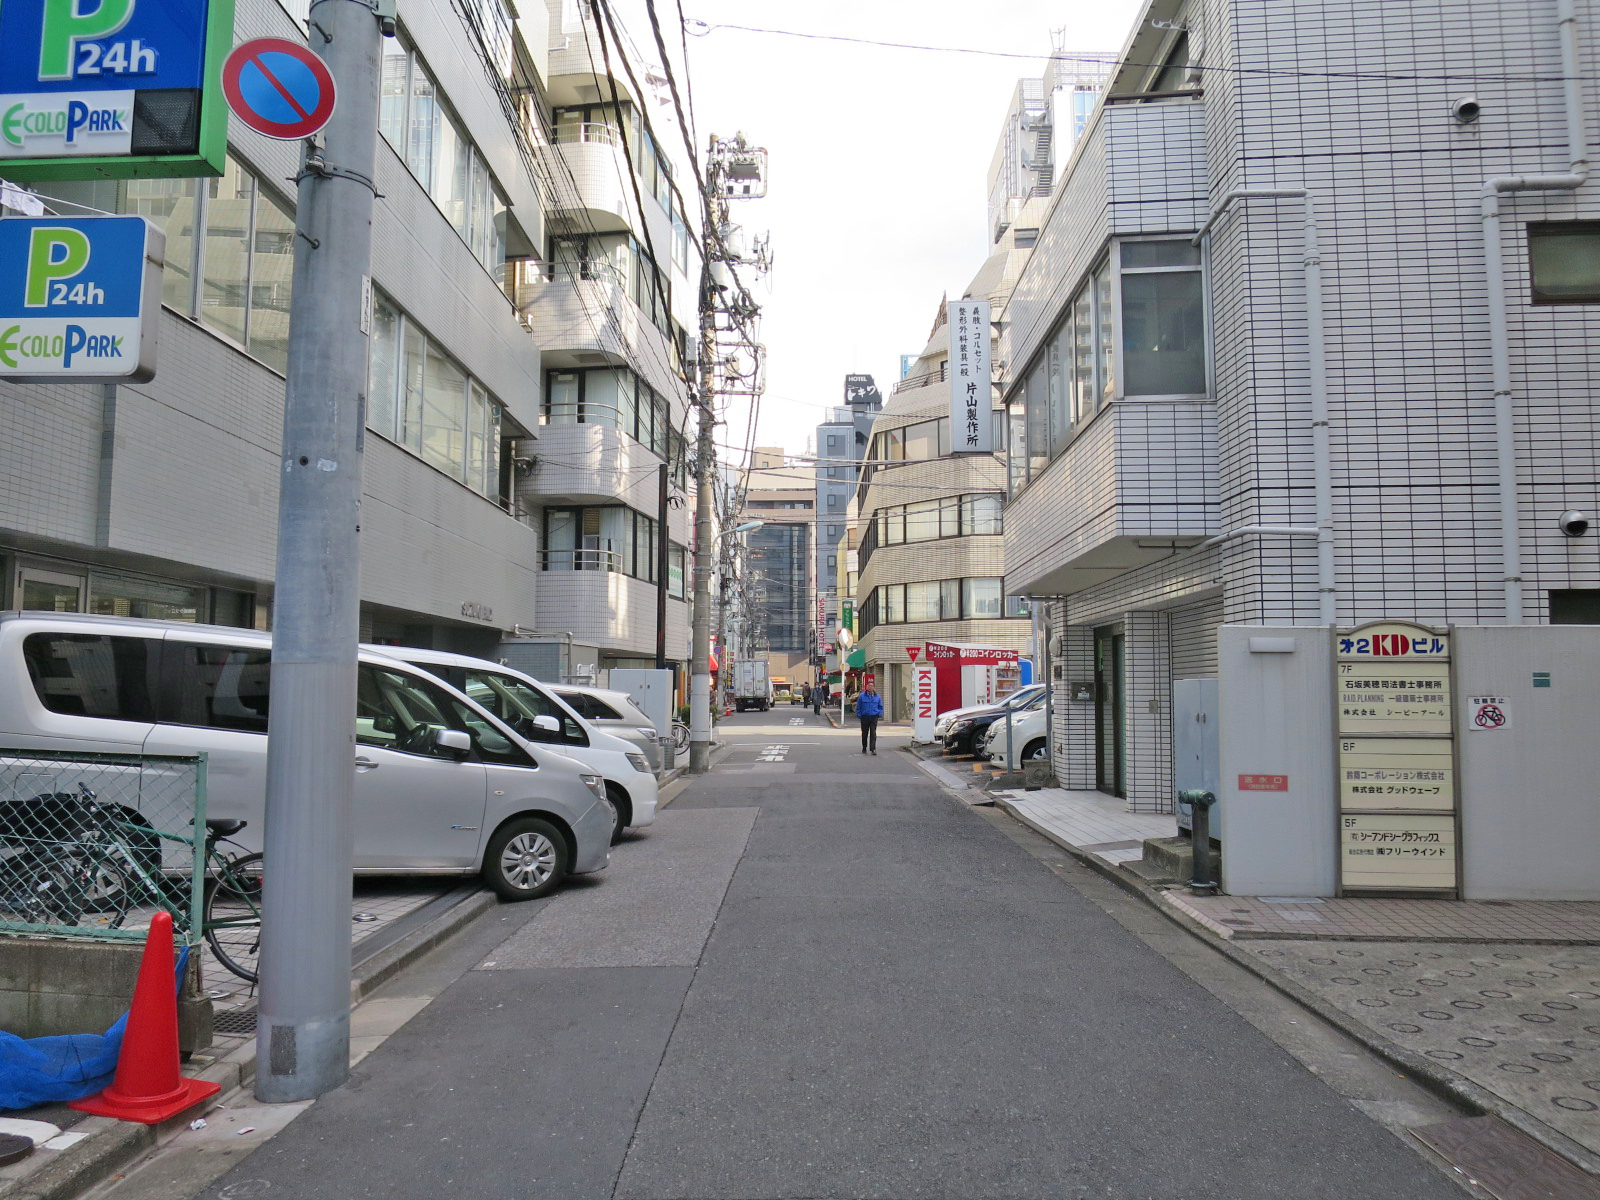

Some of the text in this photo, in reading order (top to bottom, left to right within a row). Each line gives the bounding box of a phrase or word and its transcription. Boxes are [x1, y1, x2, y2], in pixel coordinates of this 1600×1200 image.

[39, 0, 132, 81] P
[77, 42, 158, 75] 24h
[24, 227, 92, 308] P
[51, 282, 105, 305] 24h
[958, 306, 970, 377] 整形外科装具一般
[847, 385, 877, 401] トキワ
[966, 381, 979, 447] 片山製作所
[818, 597, 826, 650] SAKURA HOTEL
[1341, 665, 1353, 674] 7F
[919, 670, 931, 718] KIRIN
[1343, 708, 1376, 716] 株式会社
[1343, 742, 1355, 751] 6F
[1352, 786, 1383, 794] 株式会社
[1344, 819, 1356, 828] 5F
